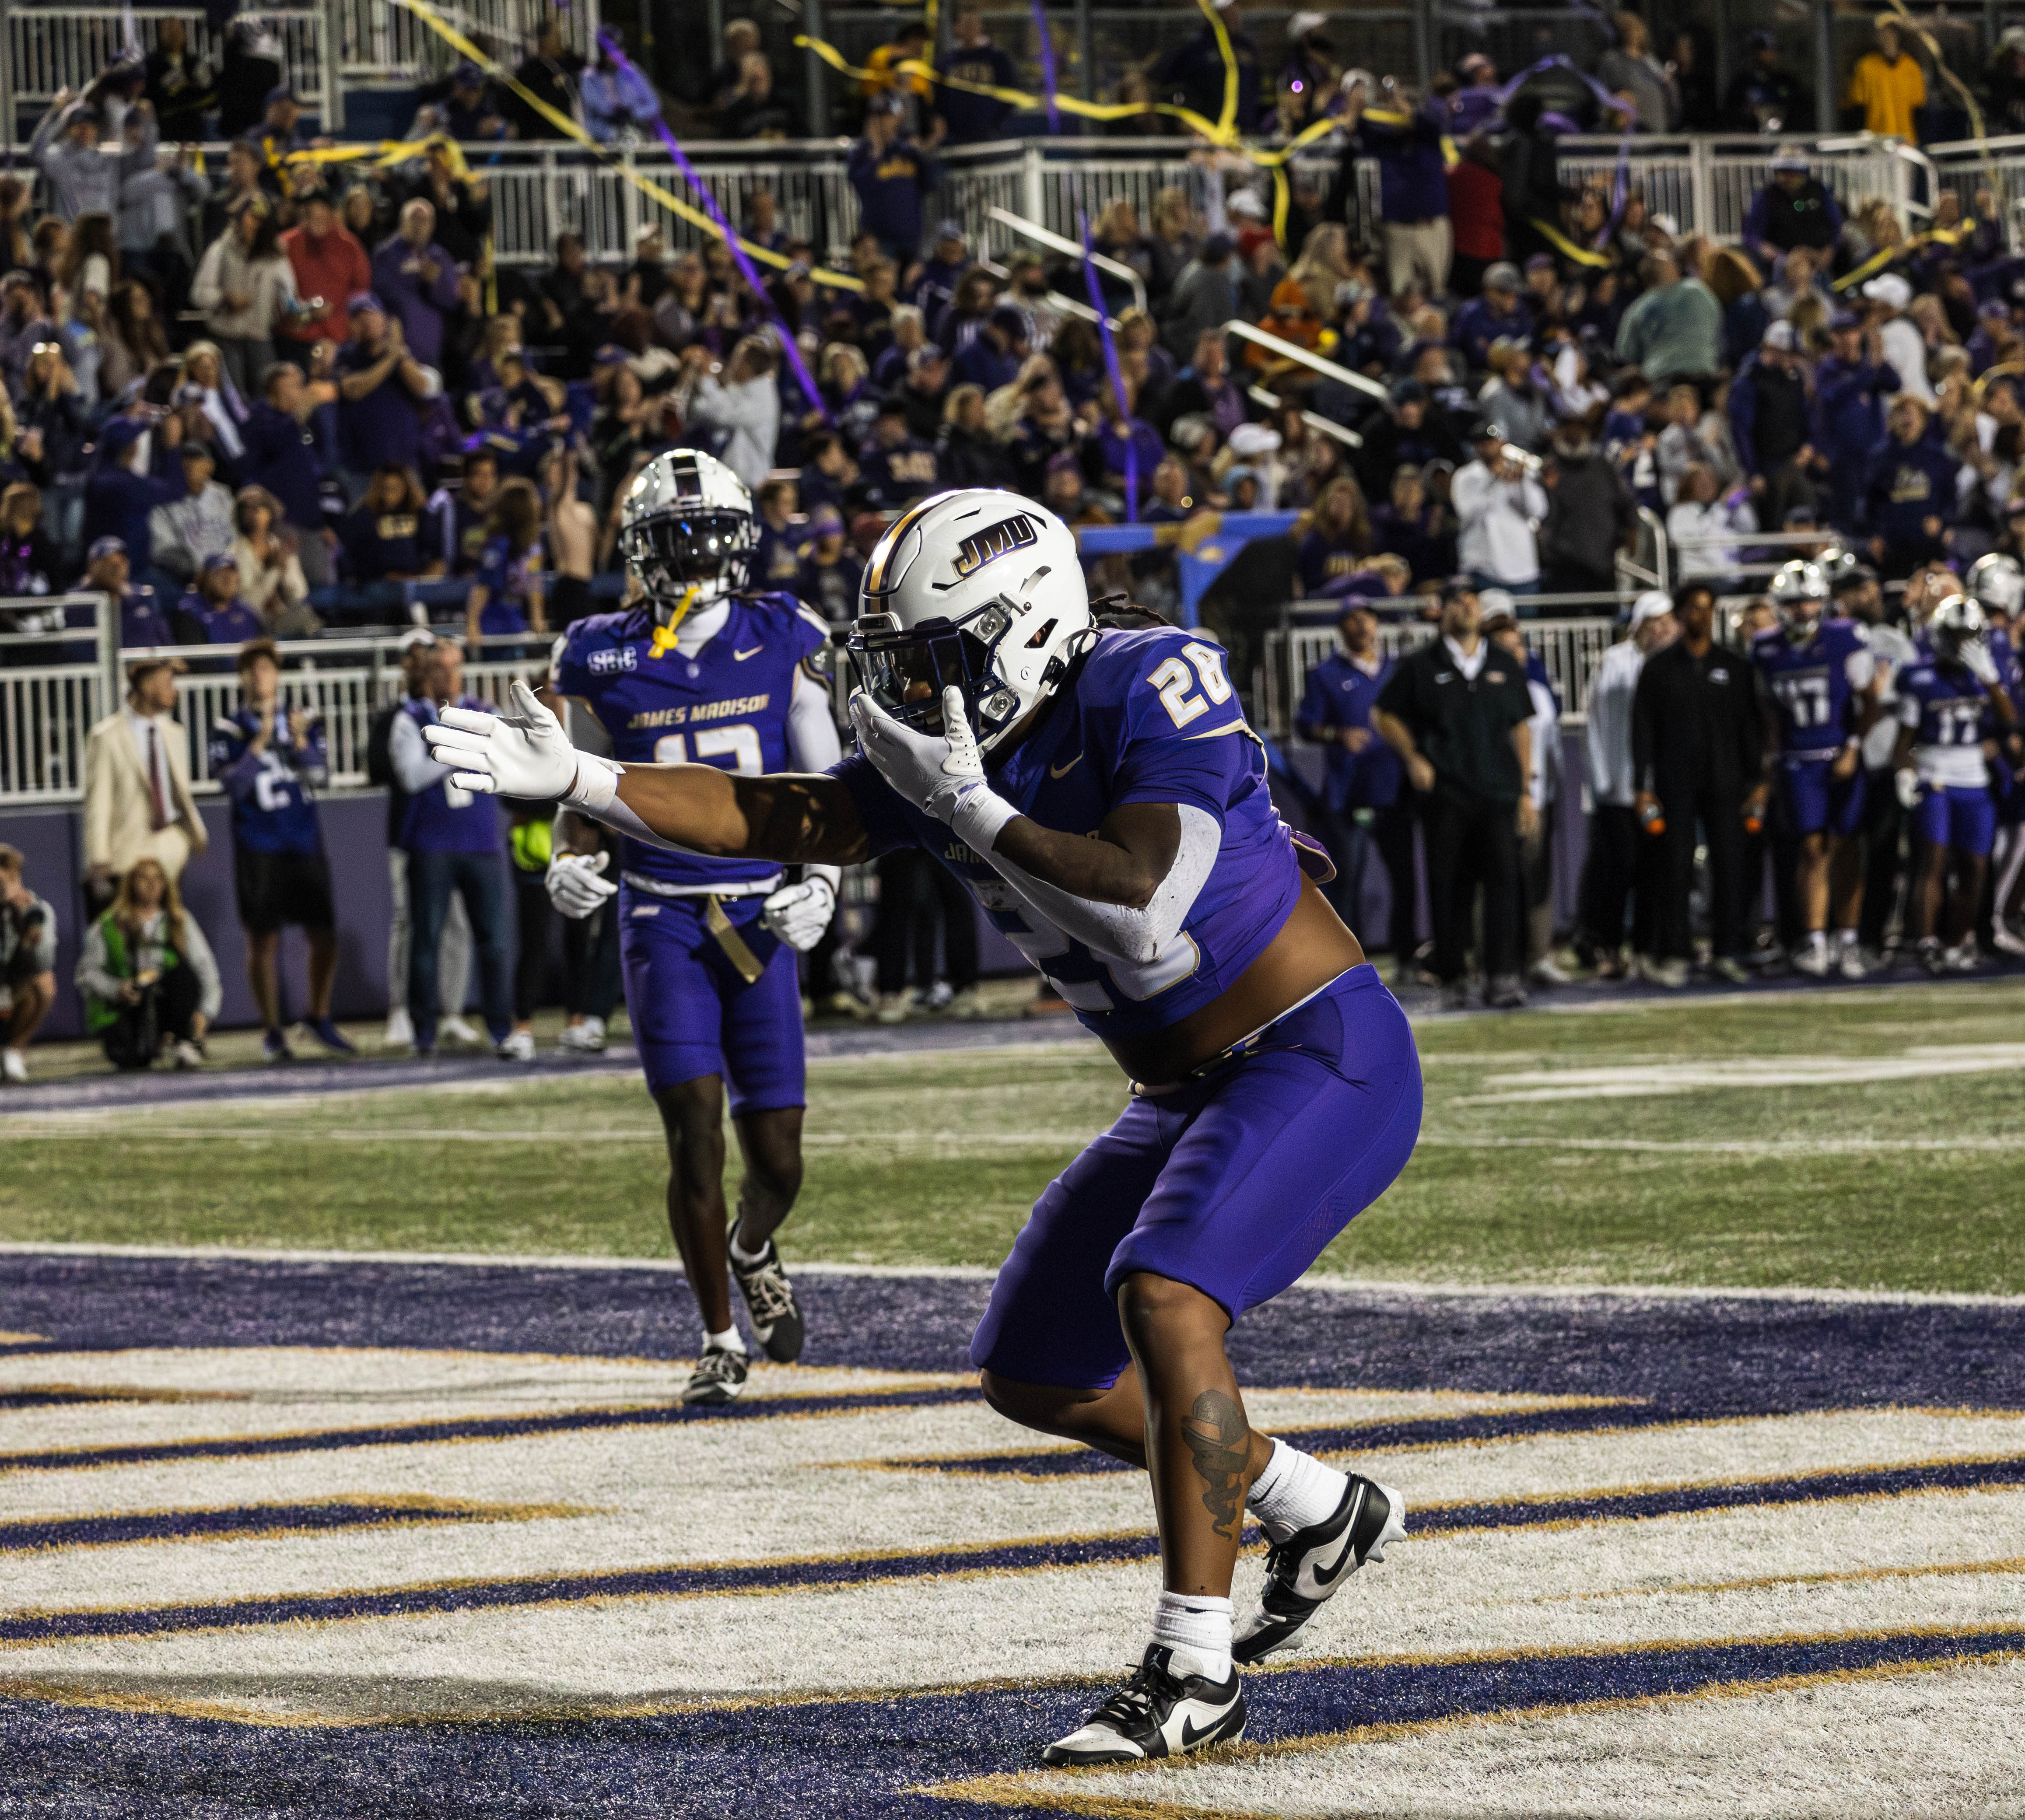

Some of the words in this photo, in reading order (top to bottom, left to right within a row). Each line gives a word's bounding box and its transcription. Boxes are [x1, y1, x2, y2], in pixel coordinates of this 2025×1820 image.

[952, 514, 1037, 578] JMU
[627, 707, 687, 729] JAMES
[690, 693, 770, 722] MADISON
[1146, 641, 1232, 729] 28
